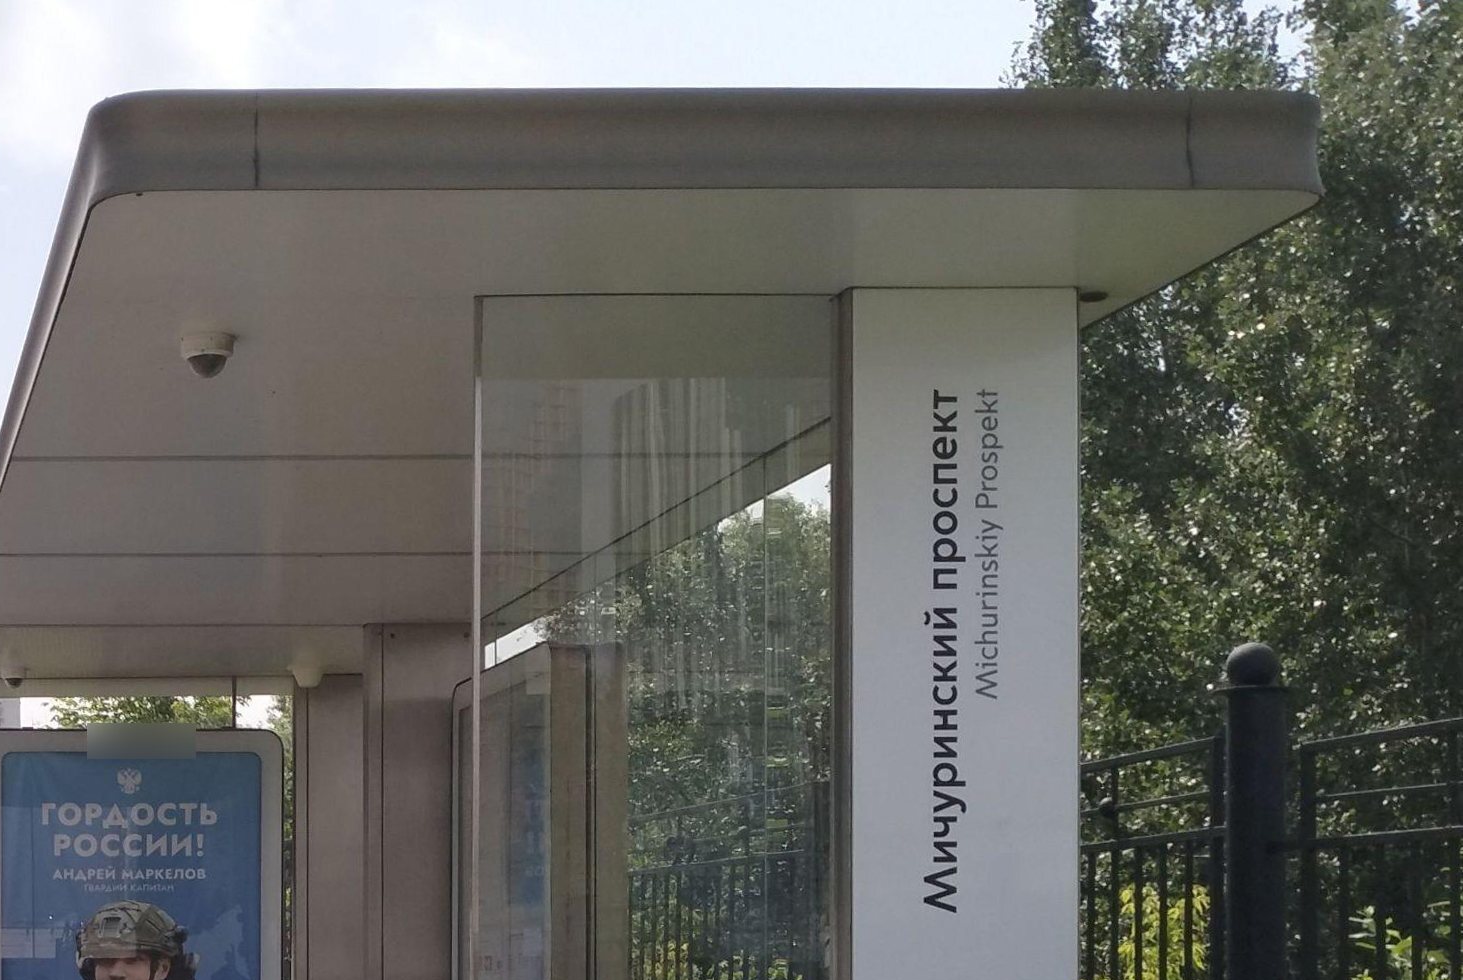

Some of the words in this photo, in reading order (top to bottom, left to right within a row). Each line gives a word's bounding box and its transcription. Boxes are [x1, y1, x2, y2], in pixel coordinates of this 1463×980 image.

[932, 389, 967, 589] проспект
[974, 388, 1004, 509] Prospekt
[974, 519, 1004, 699] Michurinskiy
[41, 802, 218, 829] ГОРДОСТЬ
[923, 607, 967, 914] Мичуринский
[52, 866, 116, 881] АНДРЕЙ
[121, 868, 207, 880] МАРКЕЛОВ
[53, 833, 205, 858] РОССИИ!
